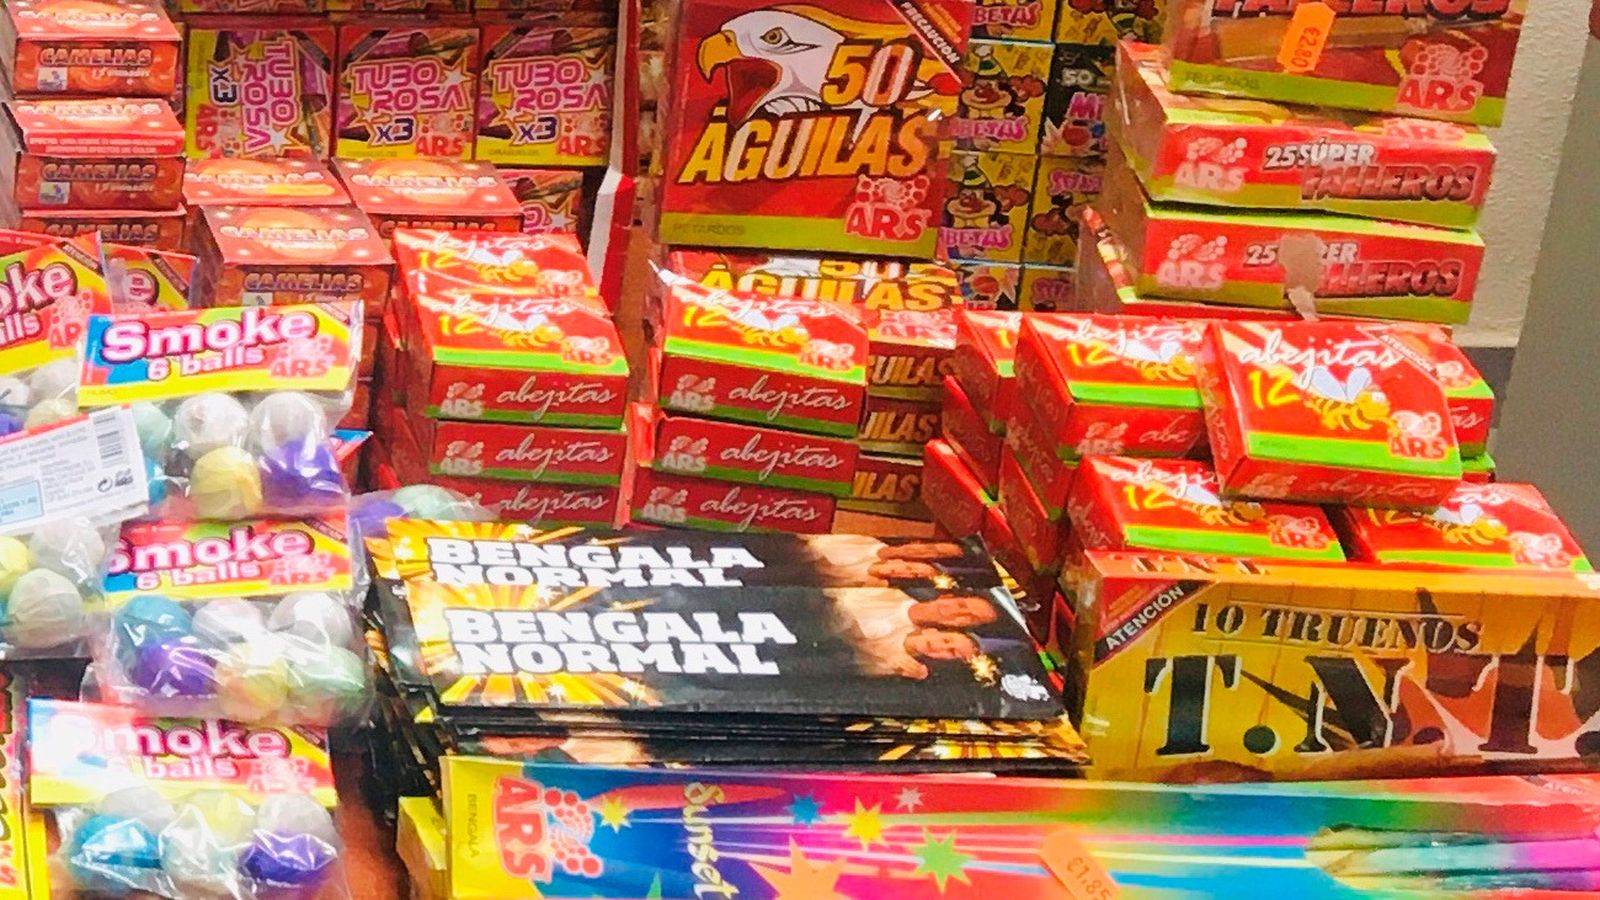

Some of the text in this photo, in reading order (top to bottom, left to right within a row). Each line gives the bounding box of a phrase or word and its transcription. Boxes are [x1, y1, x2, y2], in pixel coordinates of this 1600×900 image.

[973, 3, 1041, 28] BETAS
[39, 46, 152, 67] CAMELIAS
[354, 62, 440, 92] TUBO
[497, 62, 582, 92] TUBO
[821, 43, 915, 107] 50
[1062, 69, 1093, 87] 50
[244, 63, 272, 150] ROSA
[373, 85, 465, 112] ROSA
[514, 83, 605, 112] ROSA
[1399, 78, 1481, 112] ARS
[195, 103, 219, 151] ARS
[415, 134, 465, 156] ARS
[678, 105, 930, 184] ÁGUILAS
[42, 164, 158, 182] CAMELIAS
[1175, 164, 1247, 191] ARS
[1301, 165, 1477, 201] FALLEROS
[847, 205, 931, 240] ARS
[939, 223, 1013, 251] BETAS
[1244, 243, 1279, 267] 25
[244, 272, 364, 292] CAMELIAS
[1157, 261, 1227, 289] ARS
[1316, 261, 1463, 297] LLEROS
[439, 314, 482, 336] 12
[683, 305, 729, 327] 12
[50, 321, 82, 347] AR
[103, 308, 318, 364] Smoke
[1053, 318, 1203, 356] abejitas
[148, 342, 265, 381] 6 balls
[271, 358, 334, 378] ARS
[1066, 339, 1118, 367] 12
[1237, 328, 1405, 388] abejitas
[496, 375, 616, 421] abejitas
[668, 390, 715, 412] ARS
[727, 374, 852, 420] abejitas
[1247, 369, 1300, 410] 12
[440, 399, 484, 418] ARS
[495, 432, 615, 480] abejitas
[661, 451, 707, 473] ARS
[720, 433, 843, 481] abejitas
[1390, 436, 1448, 460] ARS
[440, 457, 484, 476] ARS
[1110, 460, 1219, 499] abeji
[498, 483, 610, 526] abejitas
[699, 486, 822, 532] abejitas
[1124, 483, 1178, 511] 12
[642, 502, 688, 524] ARS
[426, 536, 766, 569] BENGALA
[135, 560, 262, 590] 6 balls
[433, 564, 744, 588] NORMAL
[445, 609, 799, 645] BENGALA
[1191, 602, 1484, 654] 10 TRUENOS
[454, 641, 782, 676] NORMAL
[103, 718, 290, 757] moke
[144, 756, 237, 779] balls
[496, 777, 547, 877] ARS
[682, 782, 740, 900] Sunset
